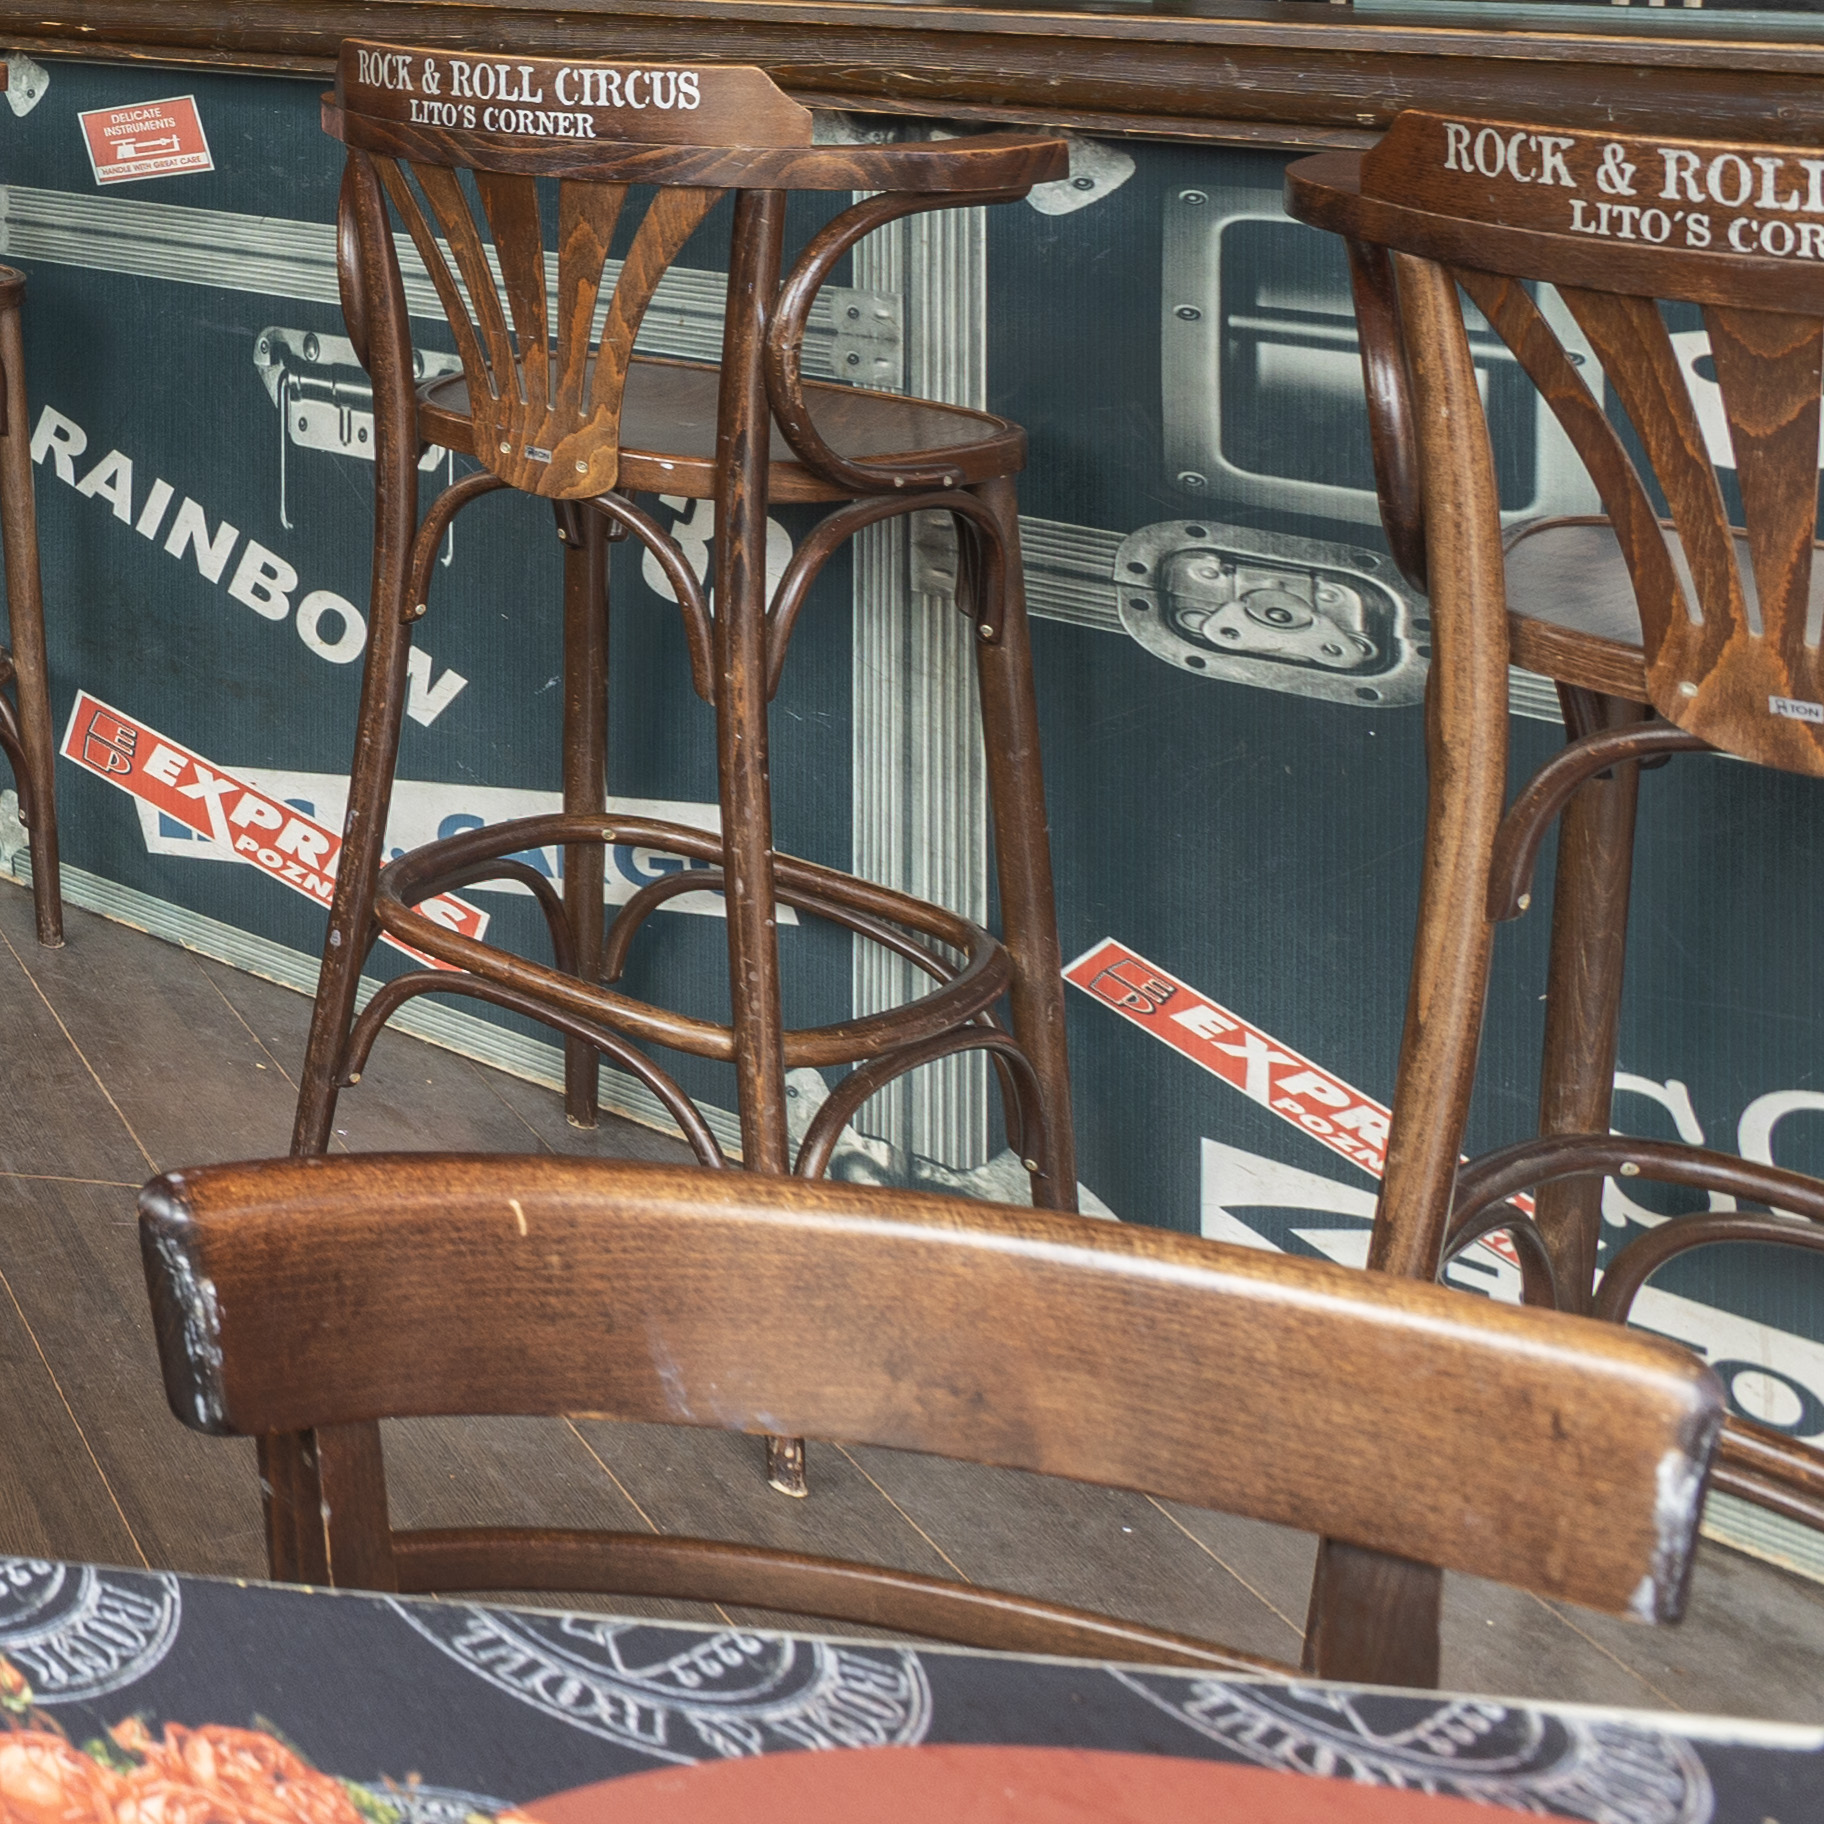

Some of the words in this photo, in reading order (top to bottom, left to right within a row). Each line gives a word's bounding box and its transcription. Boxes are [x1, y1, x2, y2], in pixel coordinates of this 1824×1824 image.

[357, 48, 414, 93] ROCK
[421, 57, 442, 94] &
[449, 60, 543, 104] ROLL
[554, 66, 702, 111] CIRCUS
[103, 117, 176, 137] INSTRUMENTS
[110, 107, 162, 124] DELICATE
[483, 106, 596, 139] CORNER
[101, 164, 132, 175] HANDLE
[133, 161, 152, 172] WITH
[153, 158, 178, 169] GREAT
[180, 155, 202, 165] CARE
[1441, 122, 1578, 189] ROCK
[1595, 142, 1638, 197] &
